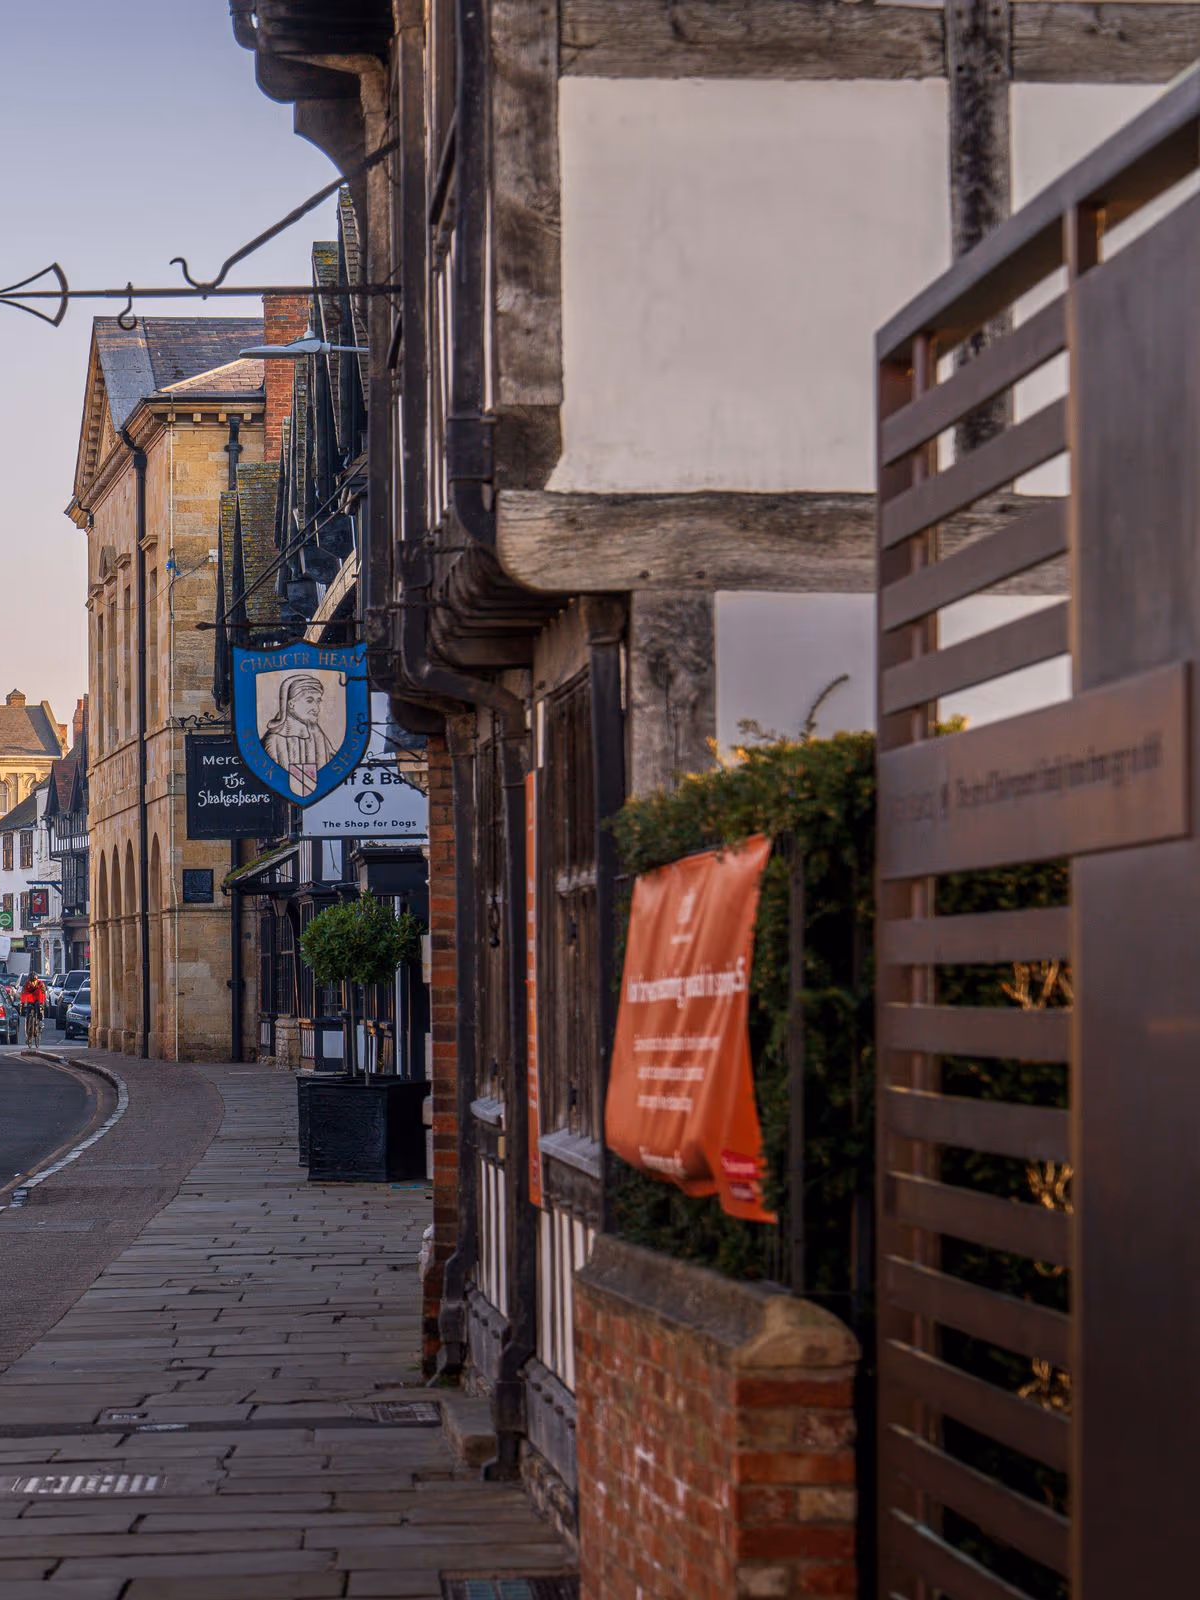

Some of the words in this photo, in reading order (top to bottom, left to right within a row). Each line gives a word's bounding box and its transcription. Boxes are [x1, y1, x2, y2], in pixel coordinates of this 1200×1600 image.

[202, 755, 242, 765] Merc
[222, 772, 245, 788] The
[362, 773, 374, 785] &
[198, 789, 270, 807] Shakespeare
[345, 820, 370, 828] Shop
[392, 820, 417, 828] Dogs
